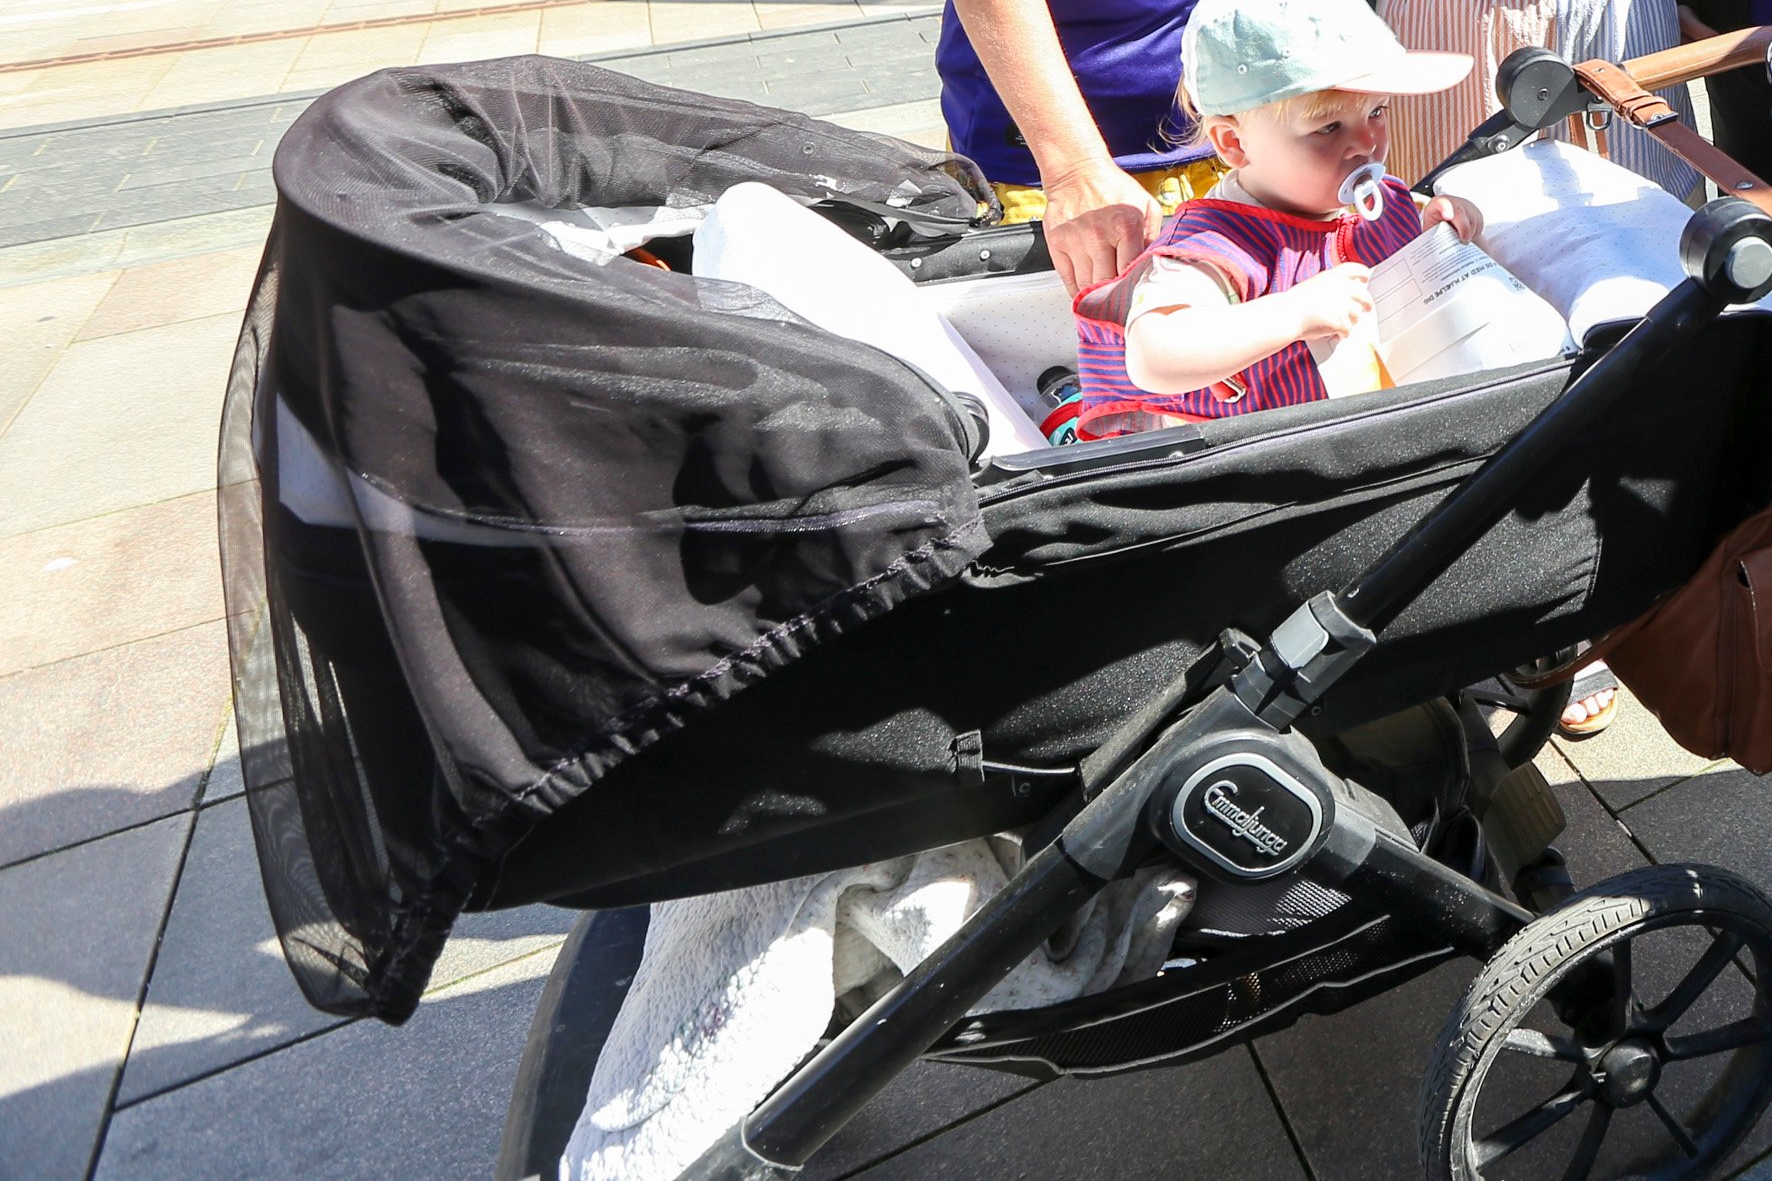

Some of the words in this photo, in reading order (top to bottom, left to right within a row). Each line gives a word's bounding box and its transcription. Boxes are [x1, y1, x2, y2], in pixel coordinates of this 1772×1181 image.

[1460, 271, 1469, 282] AT
[1423, 294, 1435, 305] DIG
[1204, 780, 1288, 855] Emmaljunga
